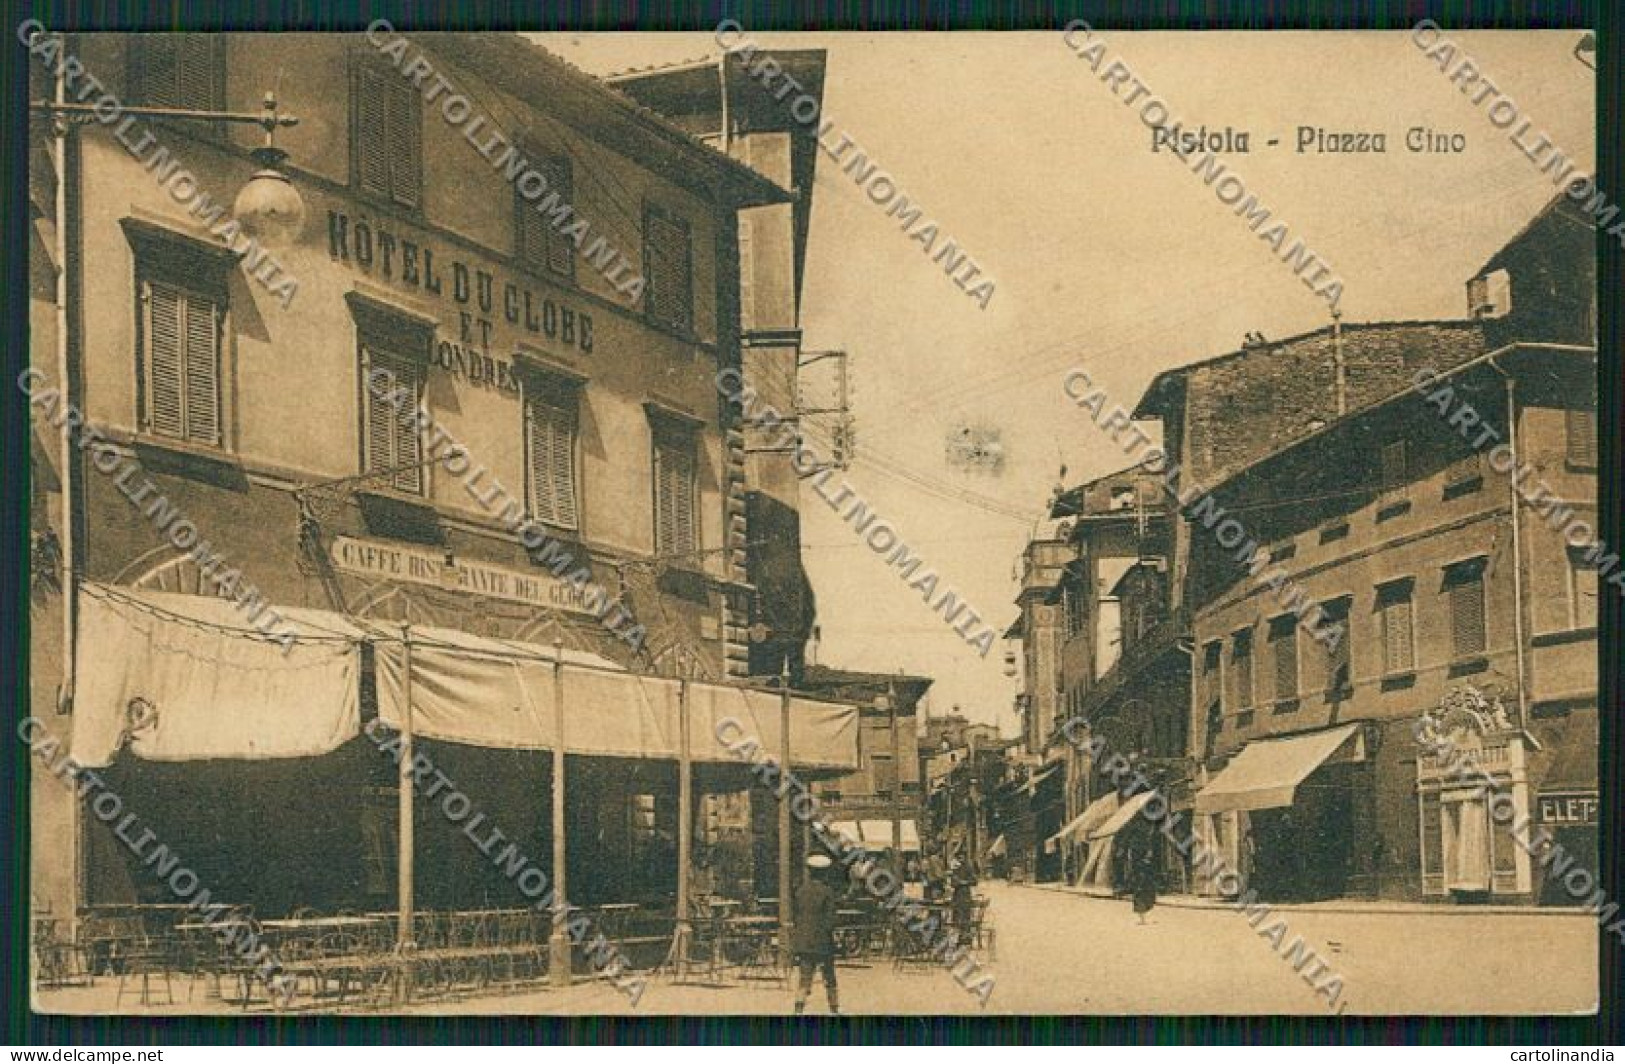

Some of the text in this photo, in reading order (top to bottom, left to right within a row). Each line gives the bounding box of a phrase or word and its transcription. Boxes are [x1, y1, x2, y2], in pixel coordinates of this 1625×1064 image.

[453, 261, 493, 313] DU
[504, 283, 594, 353] GLOBE
[460, 311, 492, 350] ET
